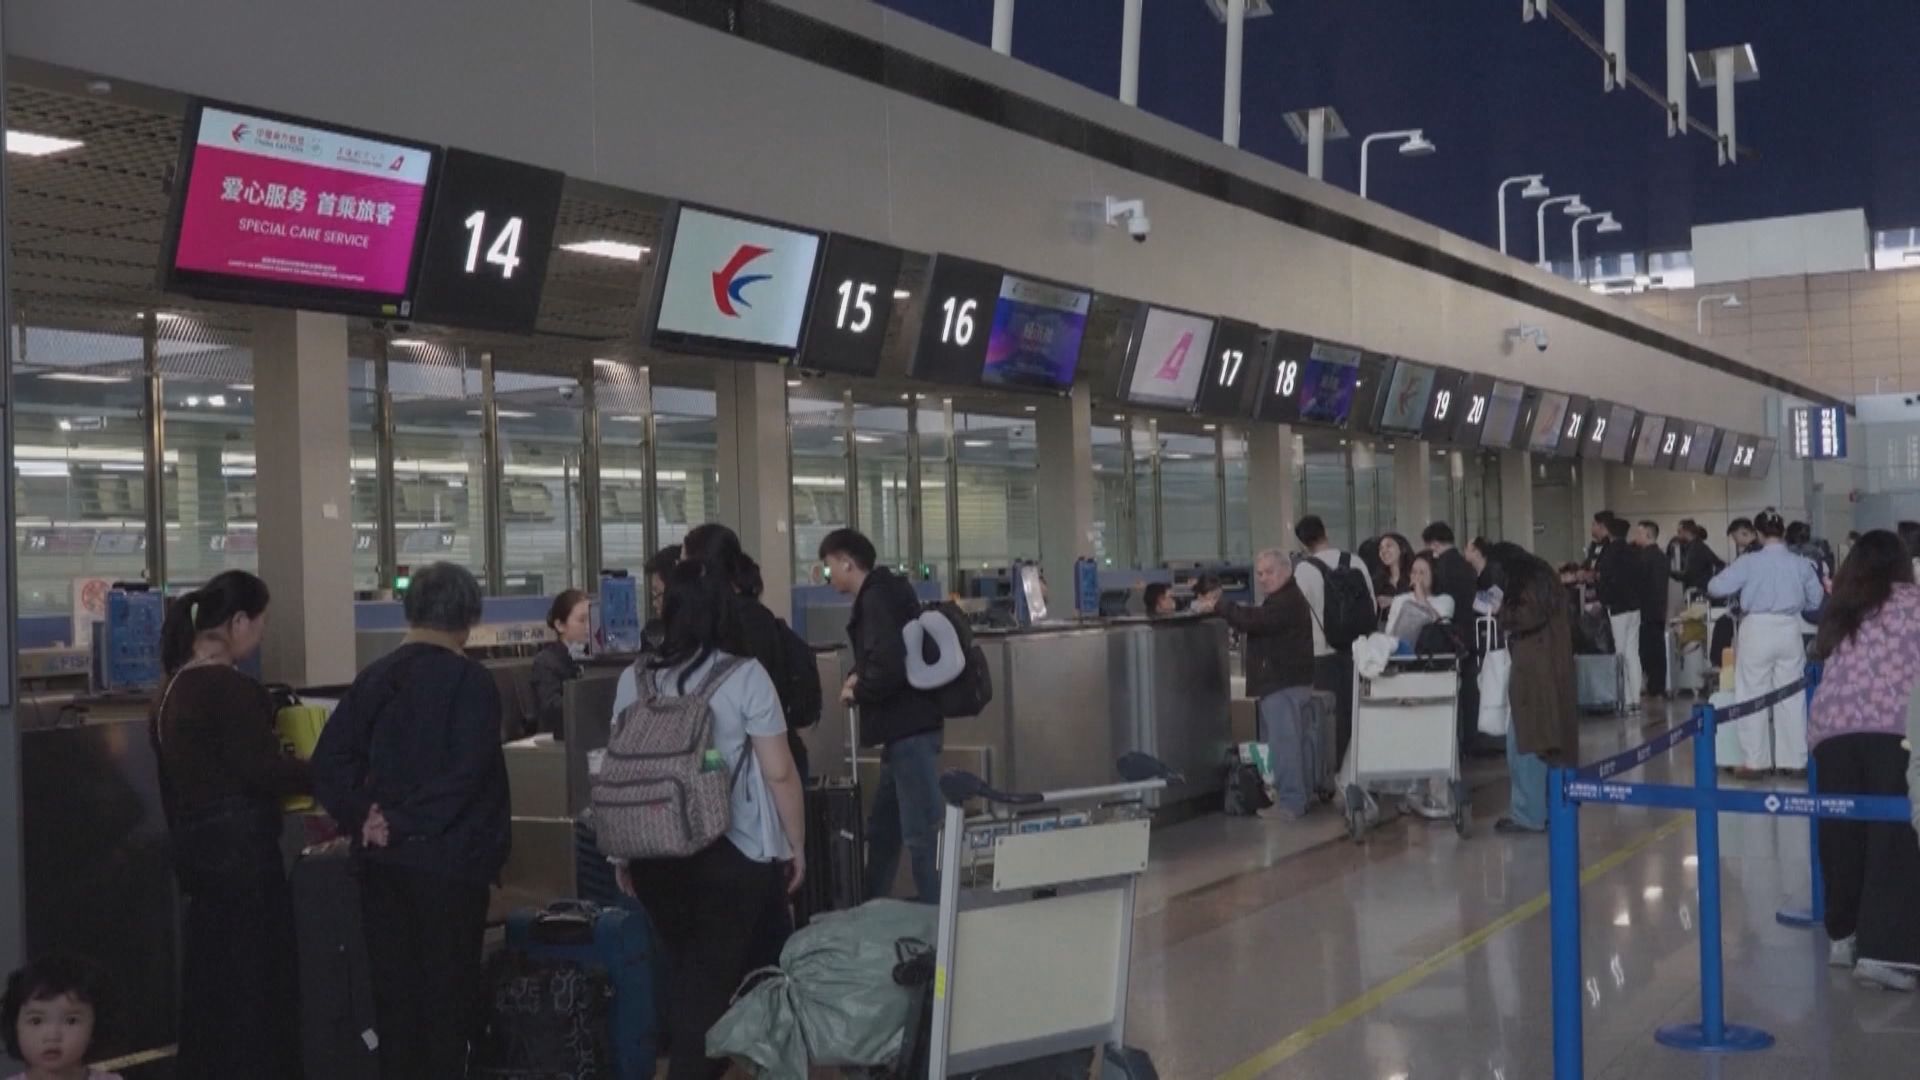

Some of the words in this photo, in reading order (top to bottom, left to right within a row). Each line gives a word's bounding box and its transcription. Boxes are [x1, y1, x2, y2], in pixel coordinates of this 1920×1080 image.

[220, 176, 307, 212] 爱心服务
[317, 192, 396, 226] 首乘旅客
[238, 218, 286, 236] SPECIAL
[289, 225, 321, 241] CARE
[323, 231, 369, 248] SERVICE
[464, 210, 523, 278] 14
[836, 279, 876, 333] 15
[941, 296, 977, 346] 16
[1219, 349, 1243, 387] 17
[1275, 360, 1298, 397] 18
[1433, 390, 1451, 420] 19
[1466, 395, 1485, 424] 20
[1567, 411, 1582, 438] 21
[1591, 416, 1606, 442] 22
